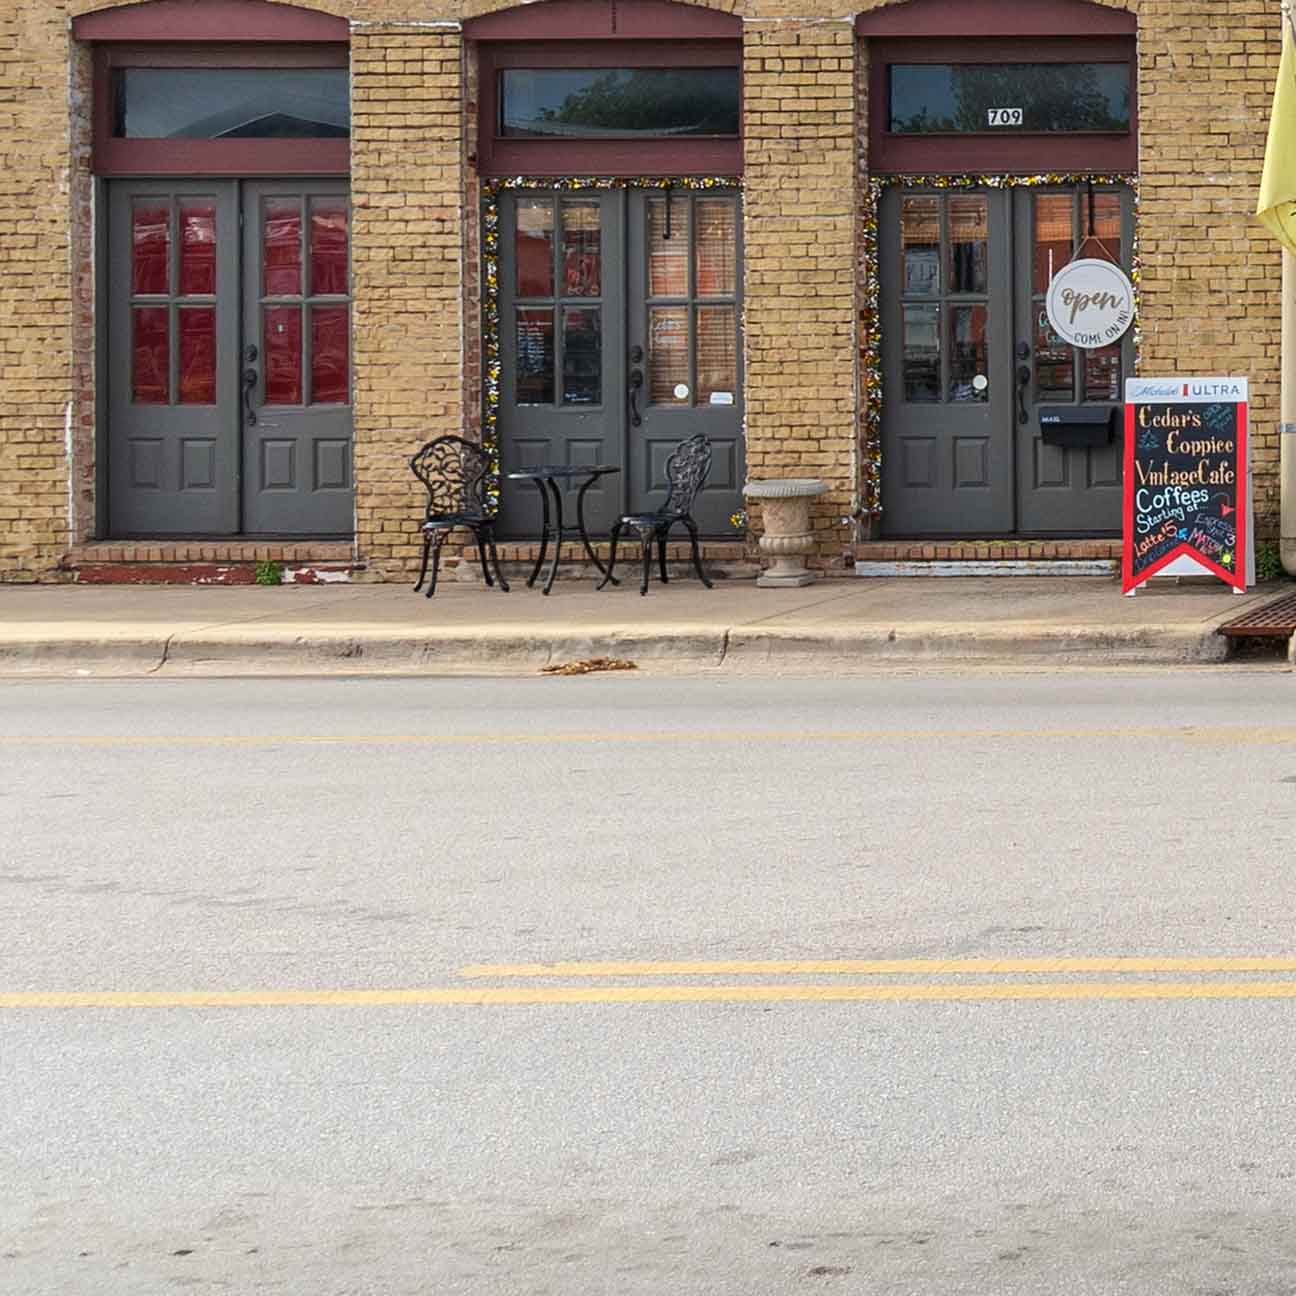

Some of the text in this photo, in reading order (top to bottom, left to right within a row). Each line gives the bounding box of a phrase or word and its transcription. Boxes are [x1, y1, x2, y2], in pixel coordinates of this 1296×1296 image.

[990, 109, 1021, 124] 709
[1073, 331, 1104, 345] COME
[1104, 322, 1121, 339] ON
[1192, 384, 1241, 396] ULTRA
[1138, 404, 1202, 428] Cedar's
[1166, 429, 1235, 457] Coppice
[1136, 486, 1209, 513] Coffees
[1136, 506, 1185, 534] Starting
[1134, 533, 1166, 557] Latte
